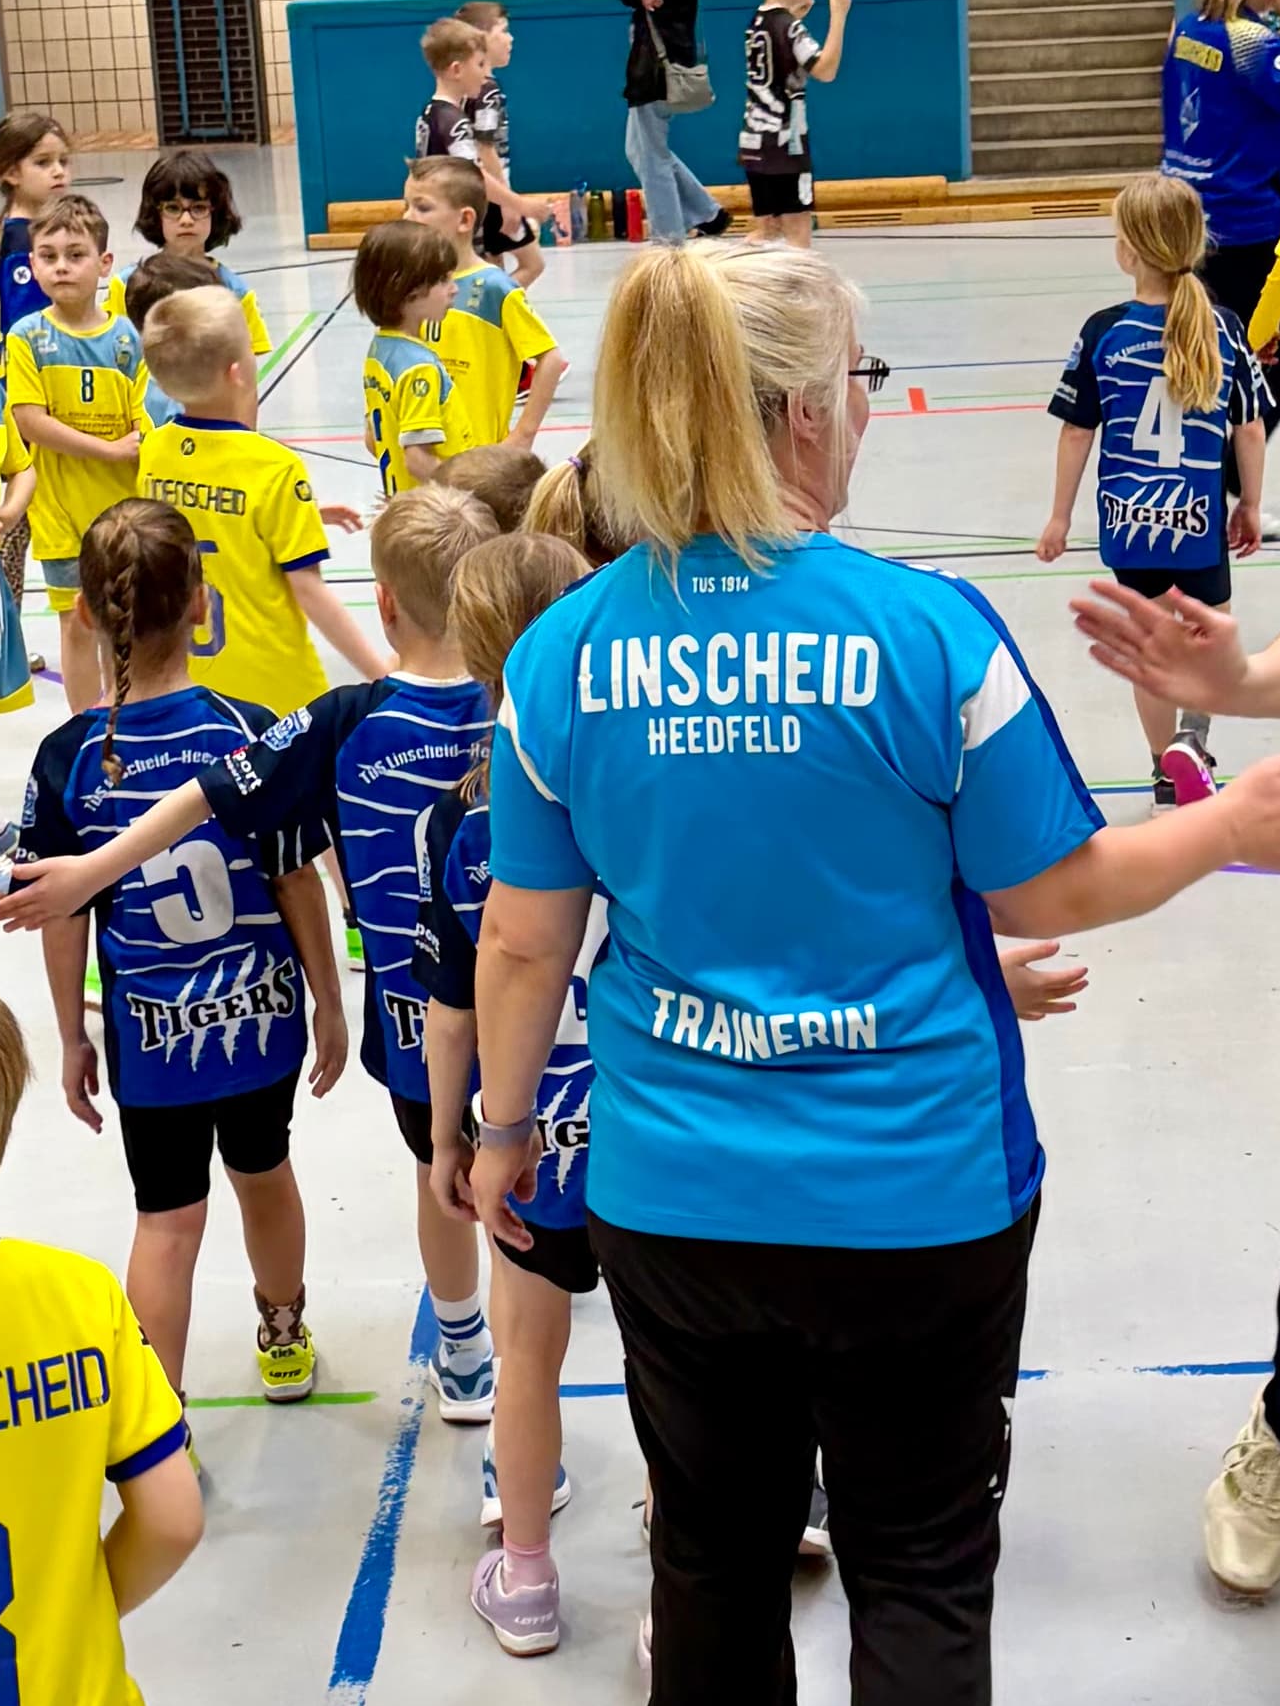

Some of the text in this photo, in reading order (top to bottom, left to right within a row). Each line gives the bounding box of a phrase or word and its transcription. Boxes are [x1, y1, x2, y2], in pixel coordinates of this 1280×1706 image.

[81, 368, 95, 403] 8
[1132, 376, 1186, 469] 4
[1102, 491, 1210, 538] TIGERS
[691, 576, 716, 594] TUS
[577, 631, 880, 714] LINSCHEID
[647, 714, 802, 756] HEEDFELD
[141, 838, 235, 945] 5
[125, 955, 298, 1053] TIGERS
[651, 986, 878, 1063] TRAINERIN
